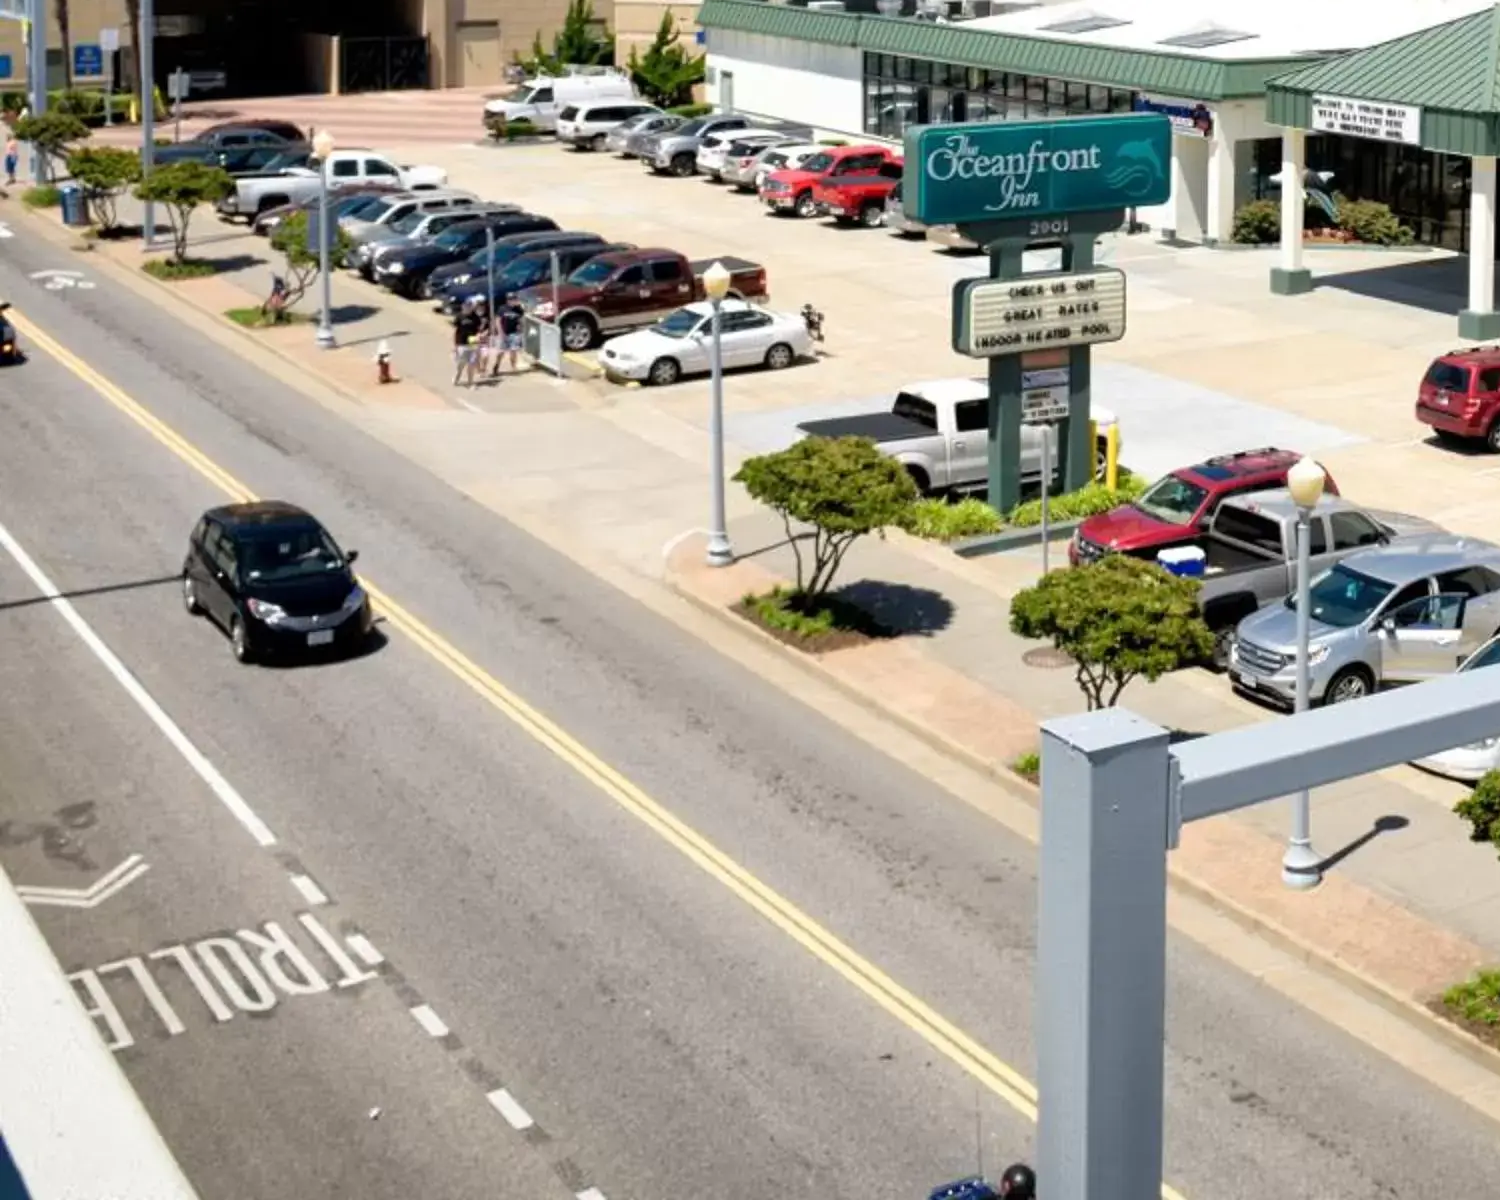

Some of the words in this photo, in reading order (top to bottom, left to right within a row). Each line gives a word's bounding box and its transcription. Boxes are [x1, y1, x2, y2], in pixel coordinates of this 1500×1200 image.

[946, 135, 980, 157] The
[927, 141, 1102, 190] Oceanfront
[985, 176, 1040, 211] Inn
[1008, 285, 1044, 298] CHECK
[1051, 282, 1066, 294] US
[1074, 280, 1095, 291] OUT
[1003, 308, 1042, 322] GREAT
[1058, 302, 1099, 316] RATES
[975, 333, 1022, 349] INDOOR
[1081, 323, 1111, 336] POOL
